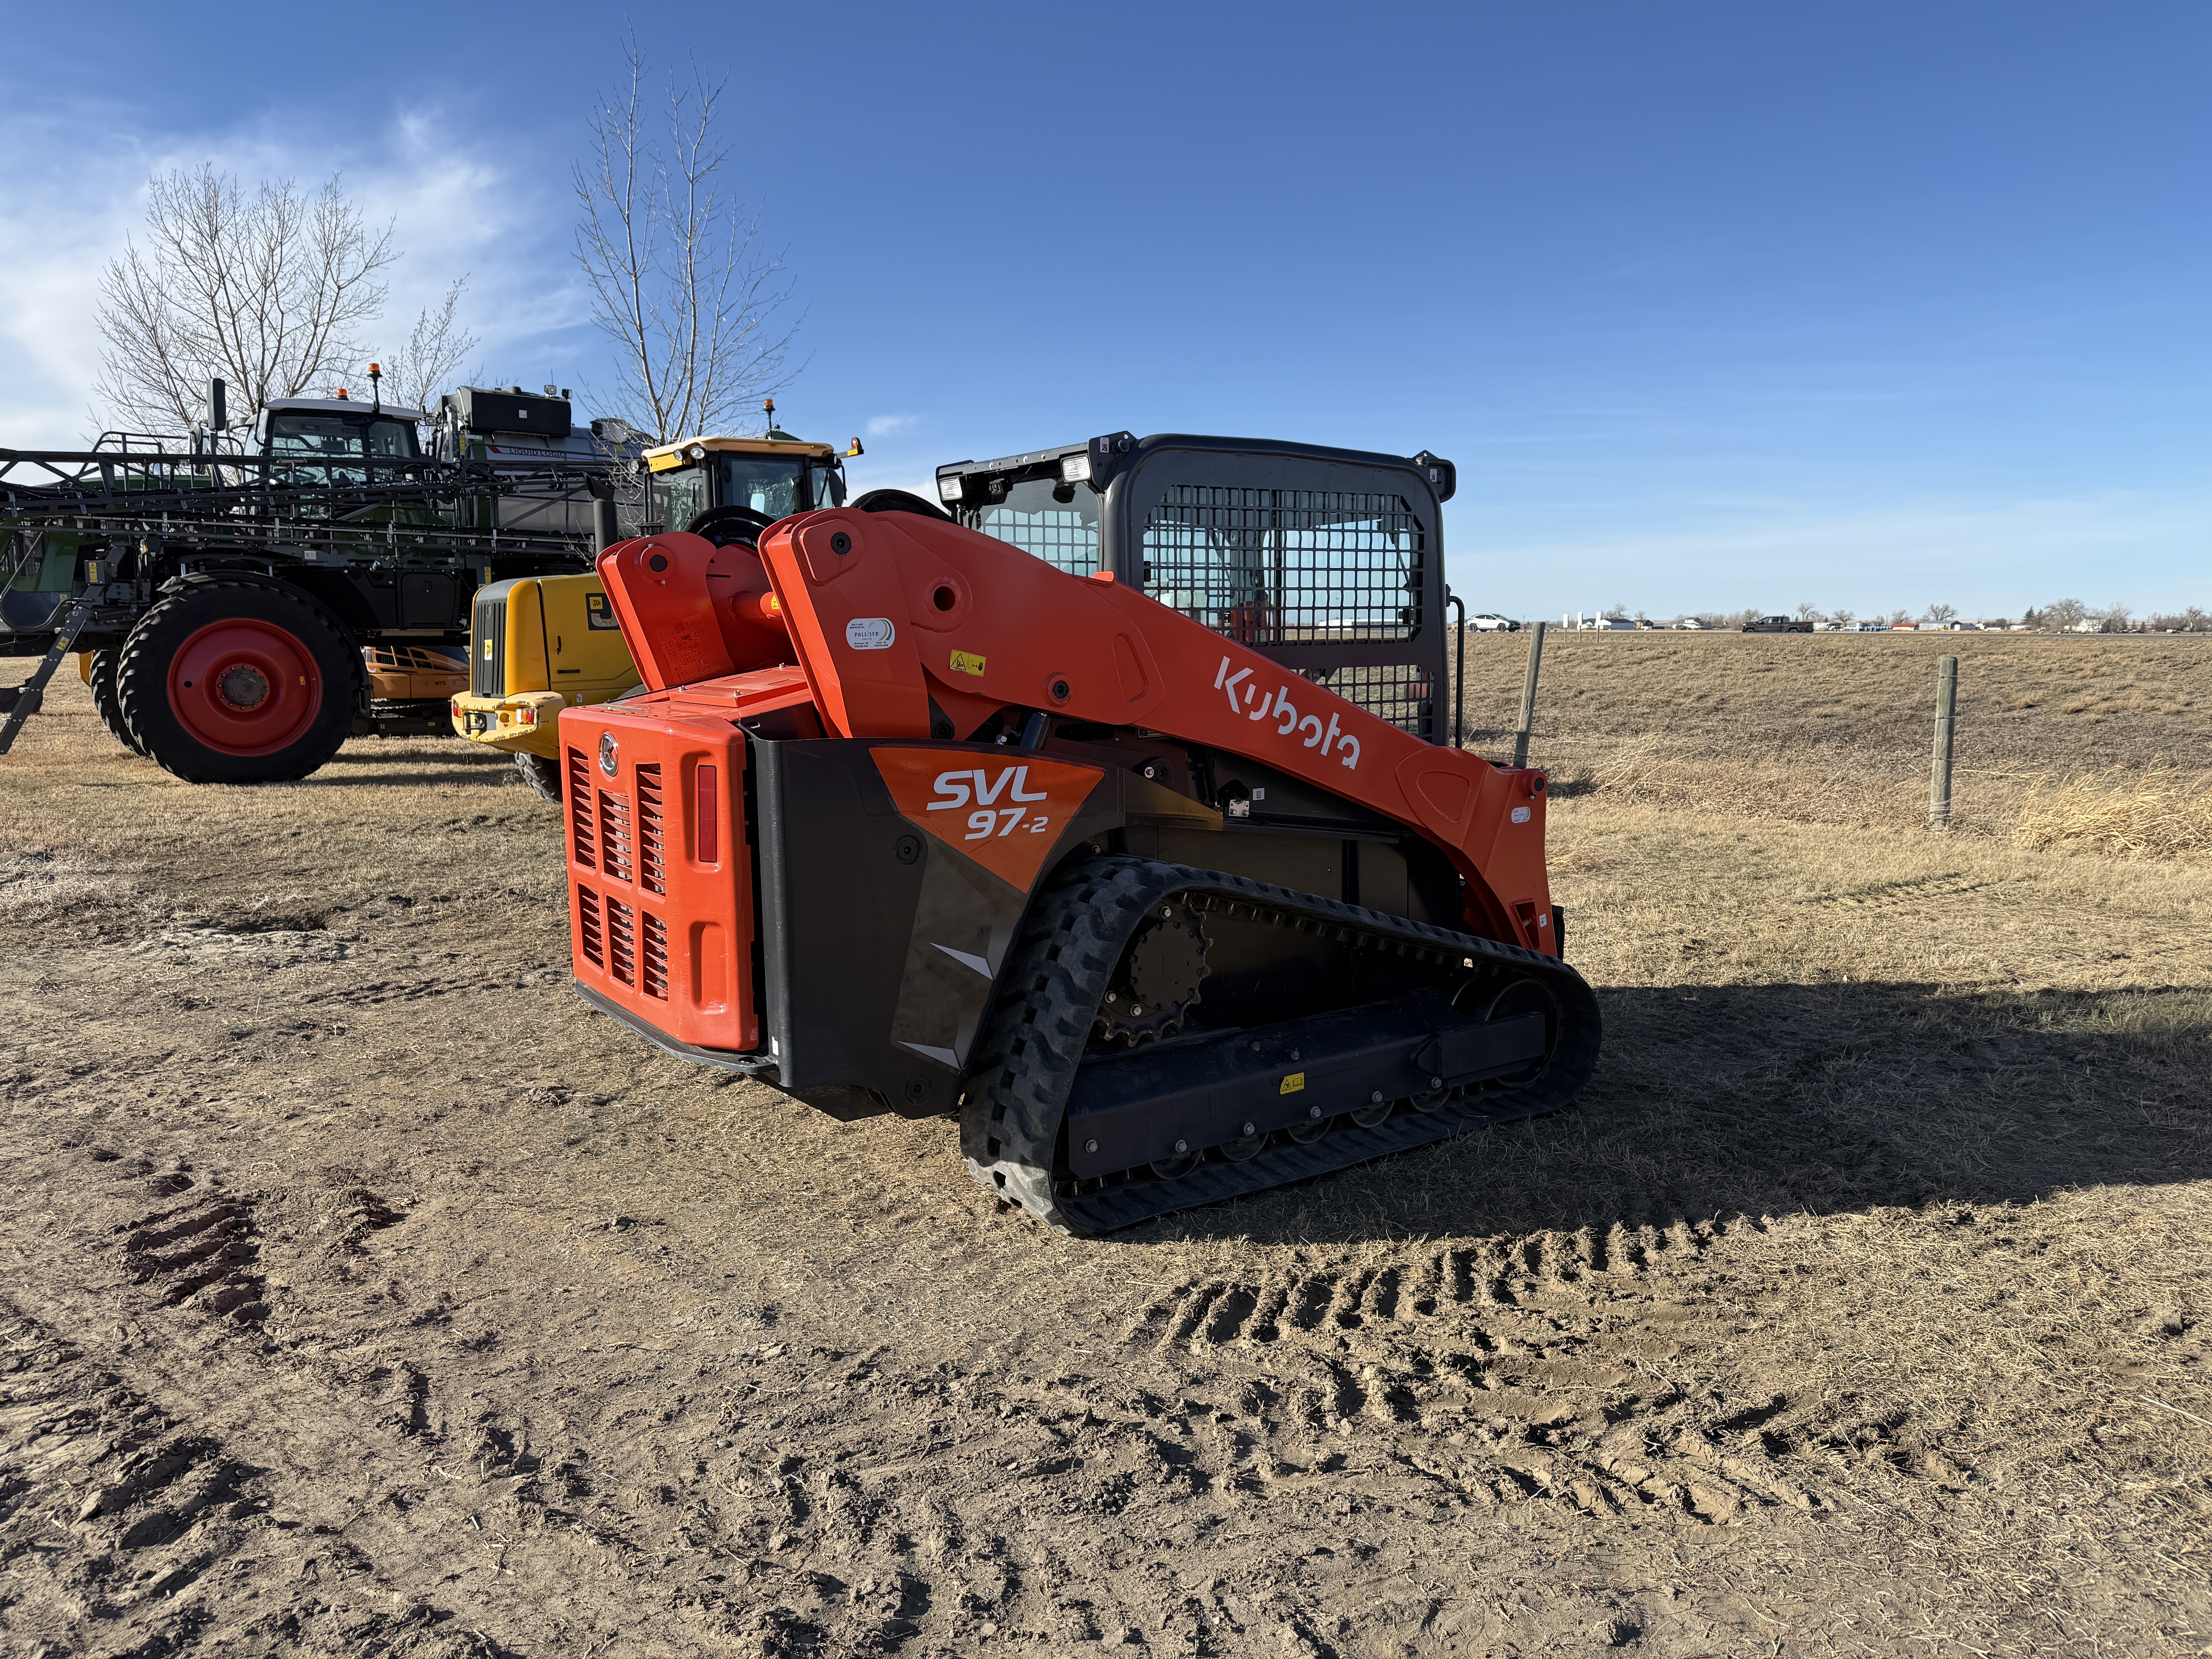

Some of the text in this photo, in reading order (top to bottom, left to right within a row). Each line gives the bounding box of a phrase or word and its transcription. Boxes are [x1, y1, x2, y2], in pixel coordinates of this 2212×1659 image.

[509, 448, 565, 458] LIQUID LOGIC
[1214, 655, 1360, 770] Kubota
[926, 766, 1048, 811] SVL
[964, 807, 1048, 840] 97-2
